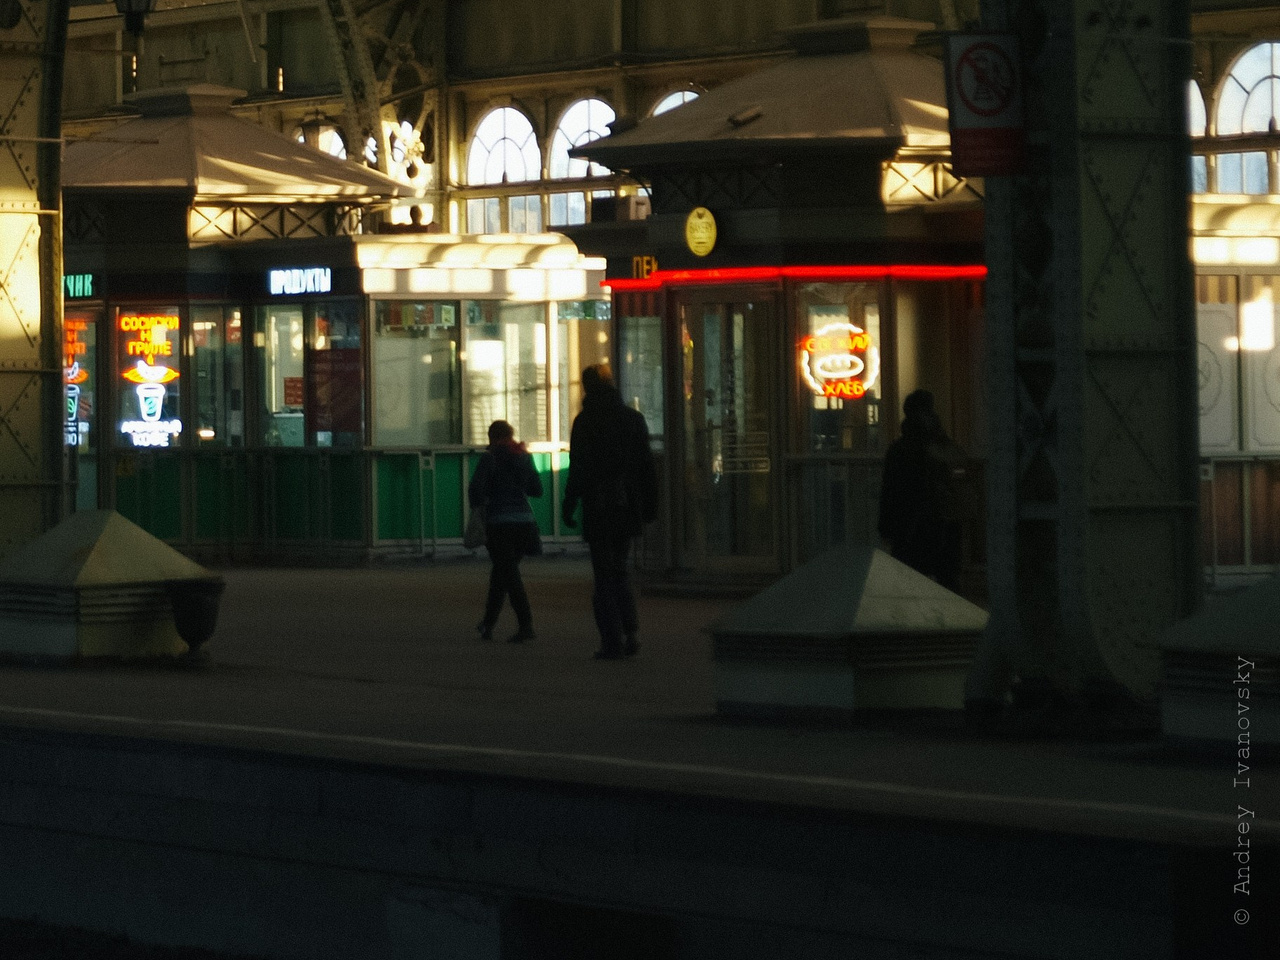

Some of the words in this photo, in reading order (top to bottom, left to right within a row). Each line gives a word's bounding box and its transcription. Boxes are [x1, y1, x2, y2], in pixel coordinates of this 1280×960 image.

[270, 267, 331, 295] ПРОДУКТЫ
[120, 316, 180, 331] СОСИСКИ
[825, 381, 864, 395] ХЛЕБ
